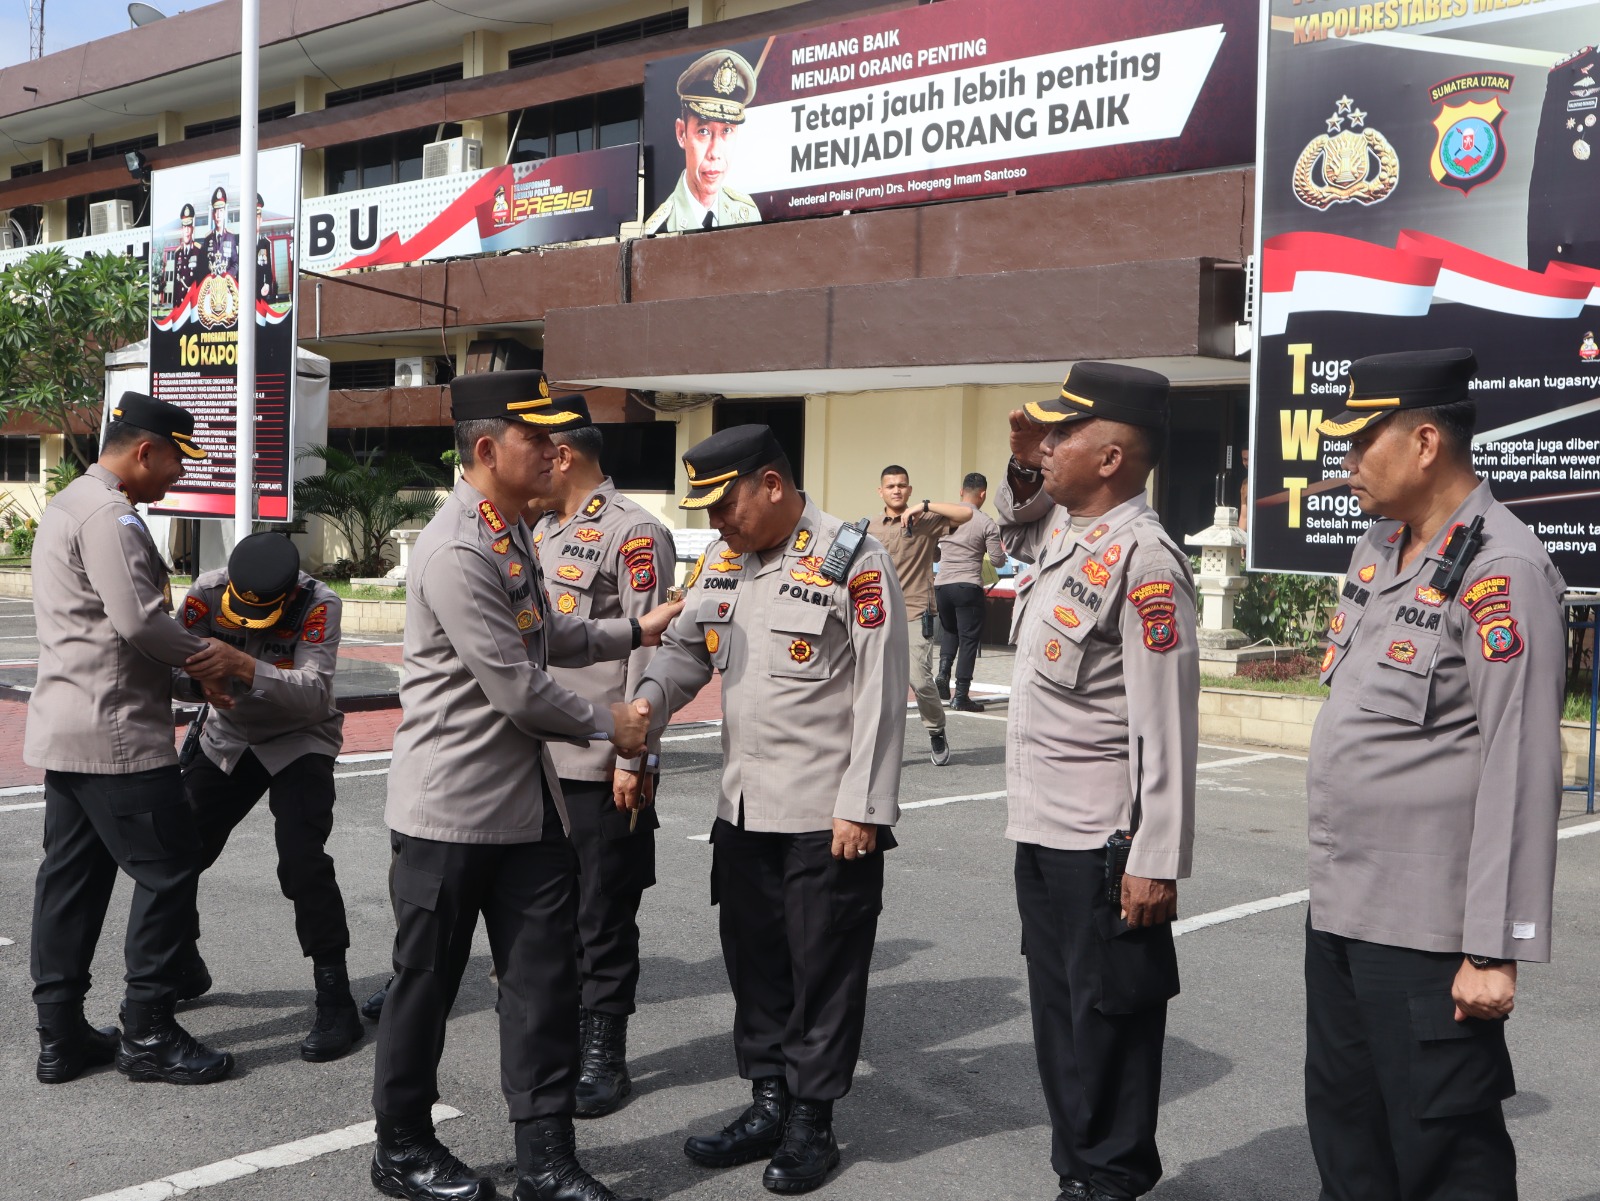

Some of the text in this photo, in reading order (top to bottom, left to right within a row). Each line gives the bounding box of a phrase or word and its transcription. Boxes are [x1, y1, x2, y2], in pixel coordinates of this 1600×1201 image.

[1293, 0, 1468, 45] KAPOLRESTABES
[791, 29, 900, 66] MEMANG BAIK
[791, 38, 987, 91] MENJADI ORANG PENTING
[791, 50, 1161, 133] Tetapi jauh lebih penting
[1431, 75, 1510, 100] SUMATERA UTARA
[790, 93, 1131, 173] MENJADI ORANG BAIK
[788, 167, 1027, 208] Jenderal Polisi (Purn) Drs. Hoegeng Imam Santoso
[513, 189, 593, 217] PRESISI
[179, 333, 200, 367] 16
[200, 343, 238, 366] KAPO
[1310, 382, 1347, 396] Setiap
[1468, 375, 1600, 390] ahami akan tugasny
[1323, 440, 1353, 452] Didal
[1486, 438, 1535, 454] anggota
[1535, 438, 1563, 453] juga
[1566, 437, 1600, 450] diber
[1472, 454, 1498, 466] krim
[1500, 453, 1557, 466] diberikan
[1491, 469, 1528, 483] upaya
[1530, 467, 1567, 483] paksa
[1569, 467, 1600, 480] lainn
[1306, 517, 1349, 529] Setelah
[1538, 522, 1585, 535] bentuk
[1305, 532, 1344, 544] adalah
[561, 544, 601, 562] POLRI
[778, 583, 829, 607] POLRI
[1061, 575, 1103, 613] POLRI
[1463, 578, 1506, 603] POLRESTABES
[1471, 585, 1499, 602] MEDAN
[1394, 605, 1442, 632] POLRI
